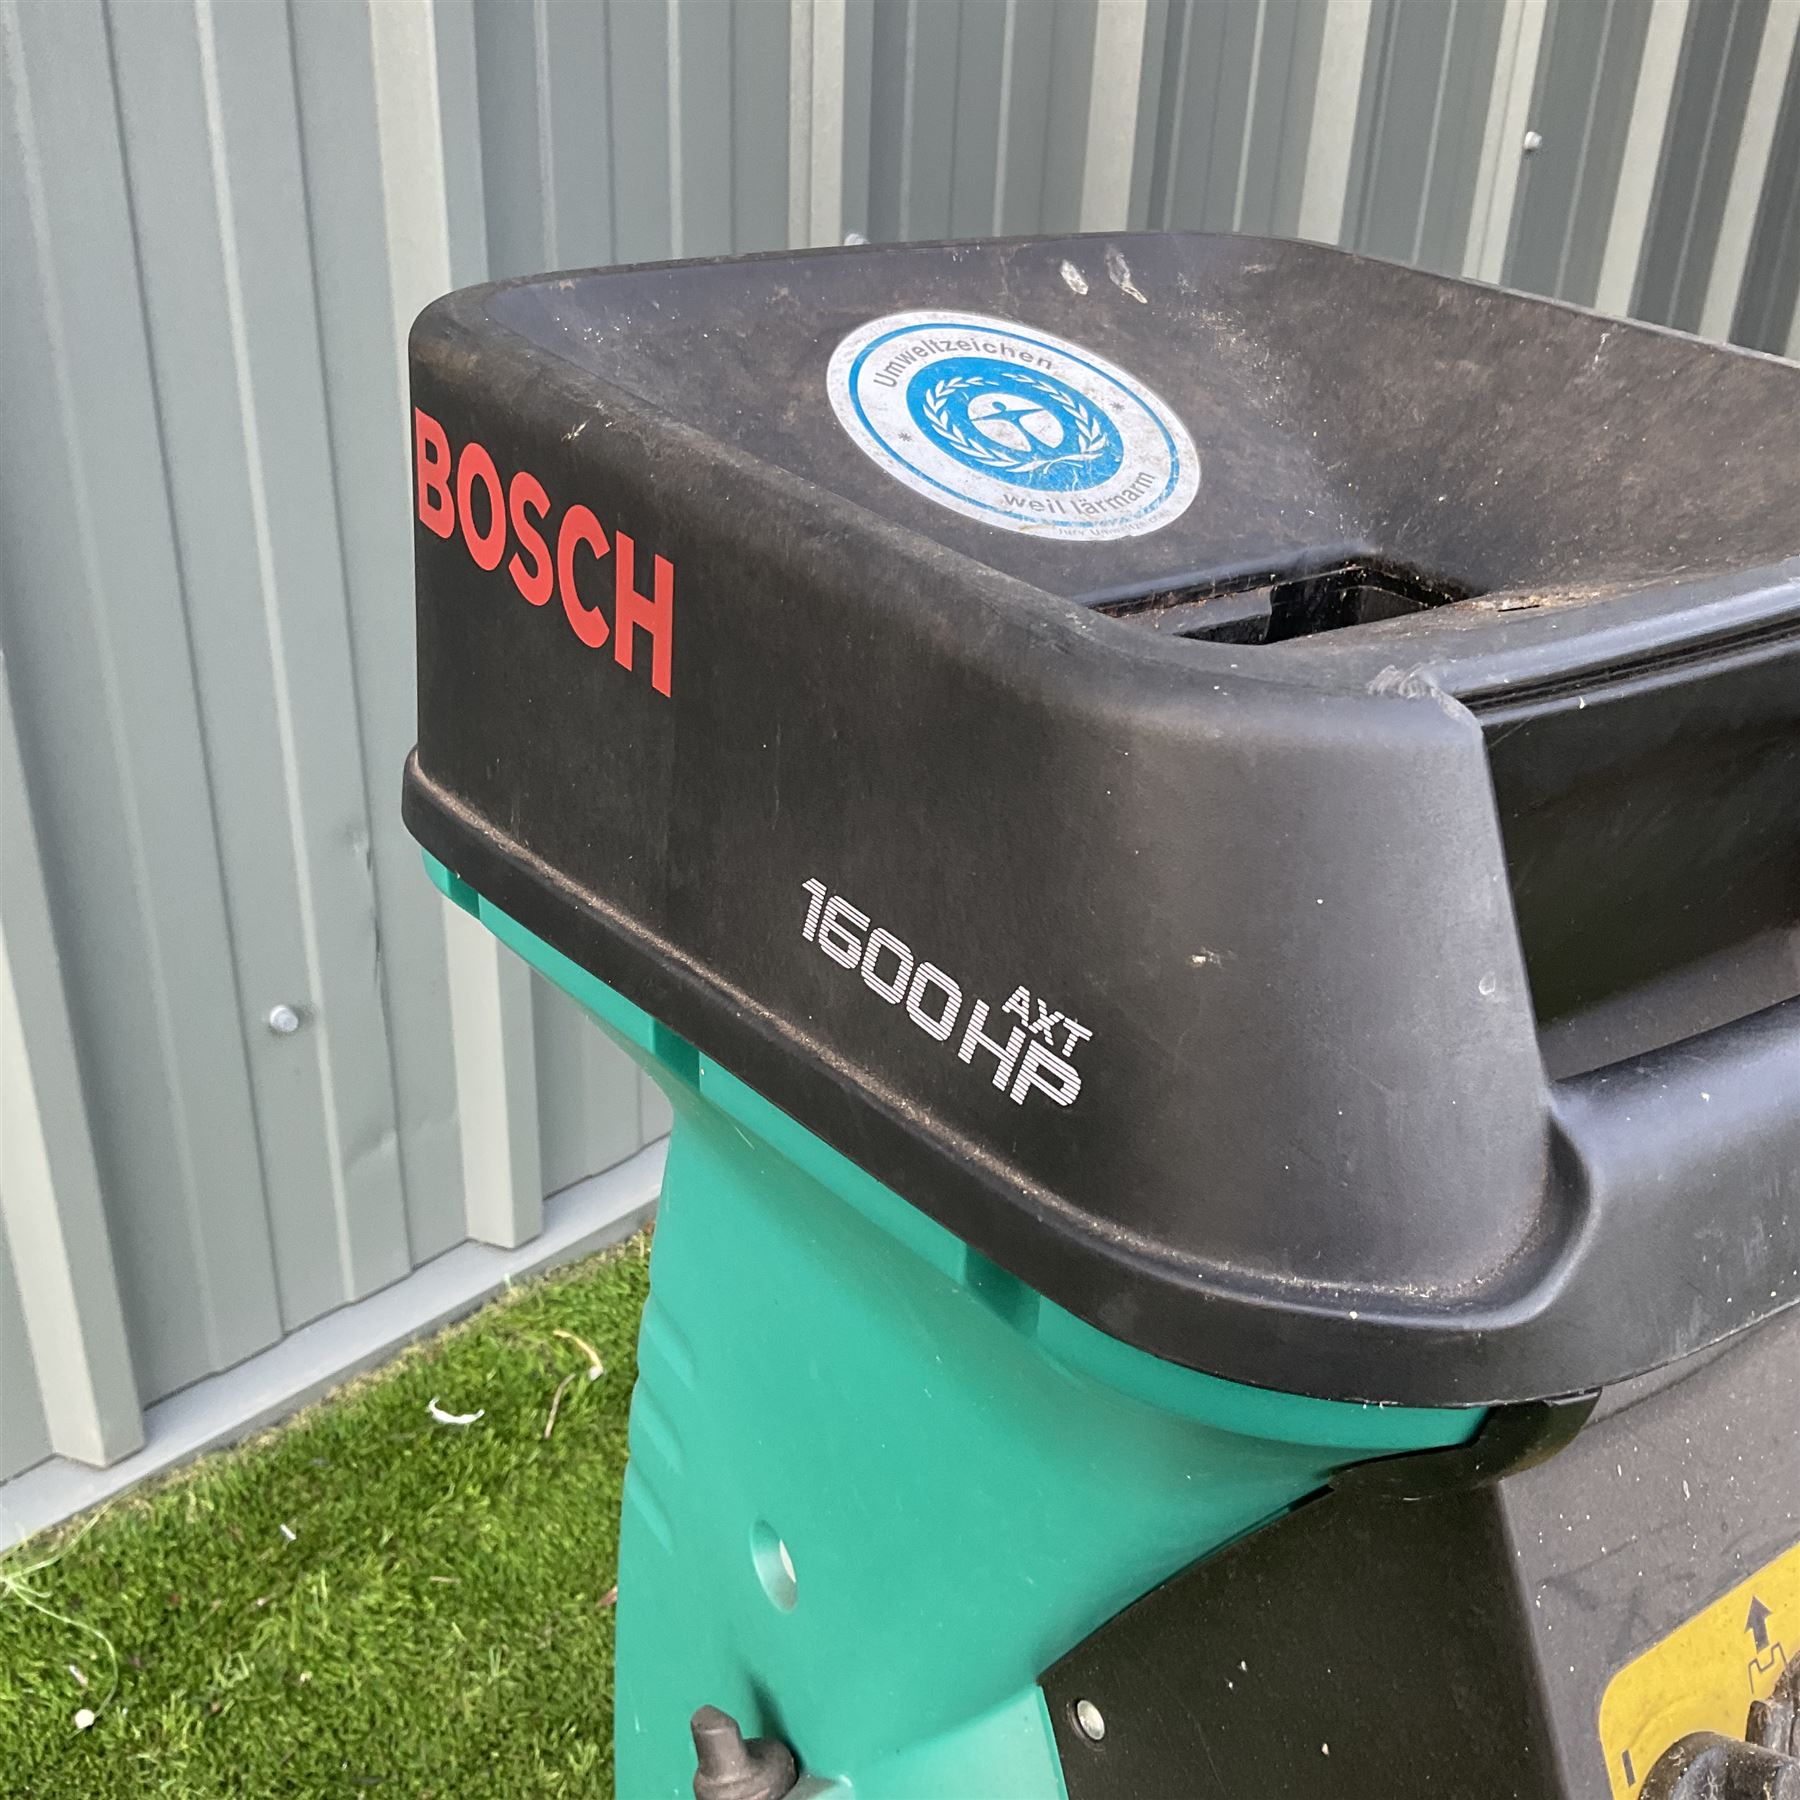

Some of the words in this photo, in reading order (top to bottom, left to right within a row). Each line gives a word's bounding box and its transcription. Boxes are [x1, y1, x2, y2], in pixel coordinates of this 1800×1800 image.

[873, 338, 1054, 389] Umweltzeichen
[1003, 494, 1067, 514] weil
[1070, 472, 1156, 515] lärmarm
[415, 406, 674, 698] BOSCH
[1002, 985, 1093, 1057] AXT
